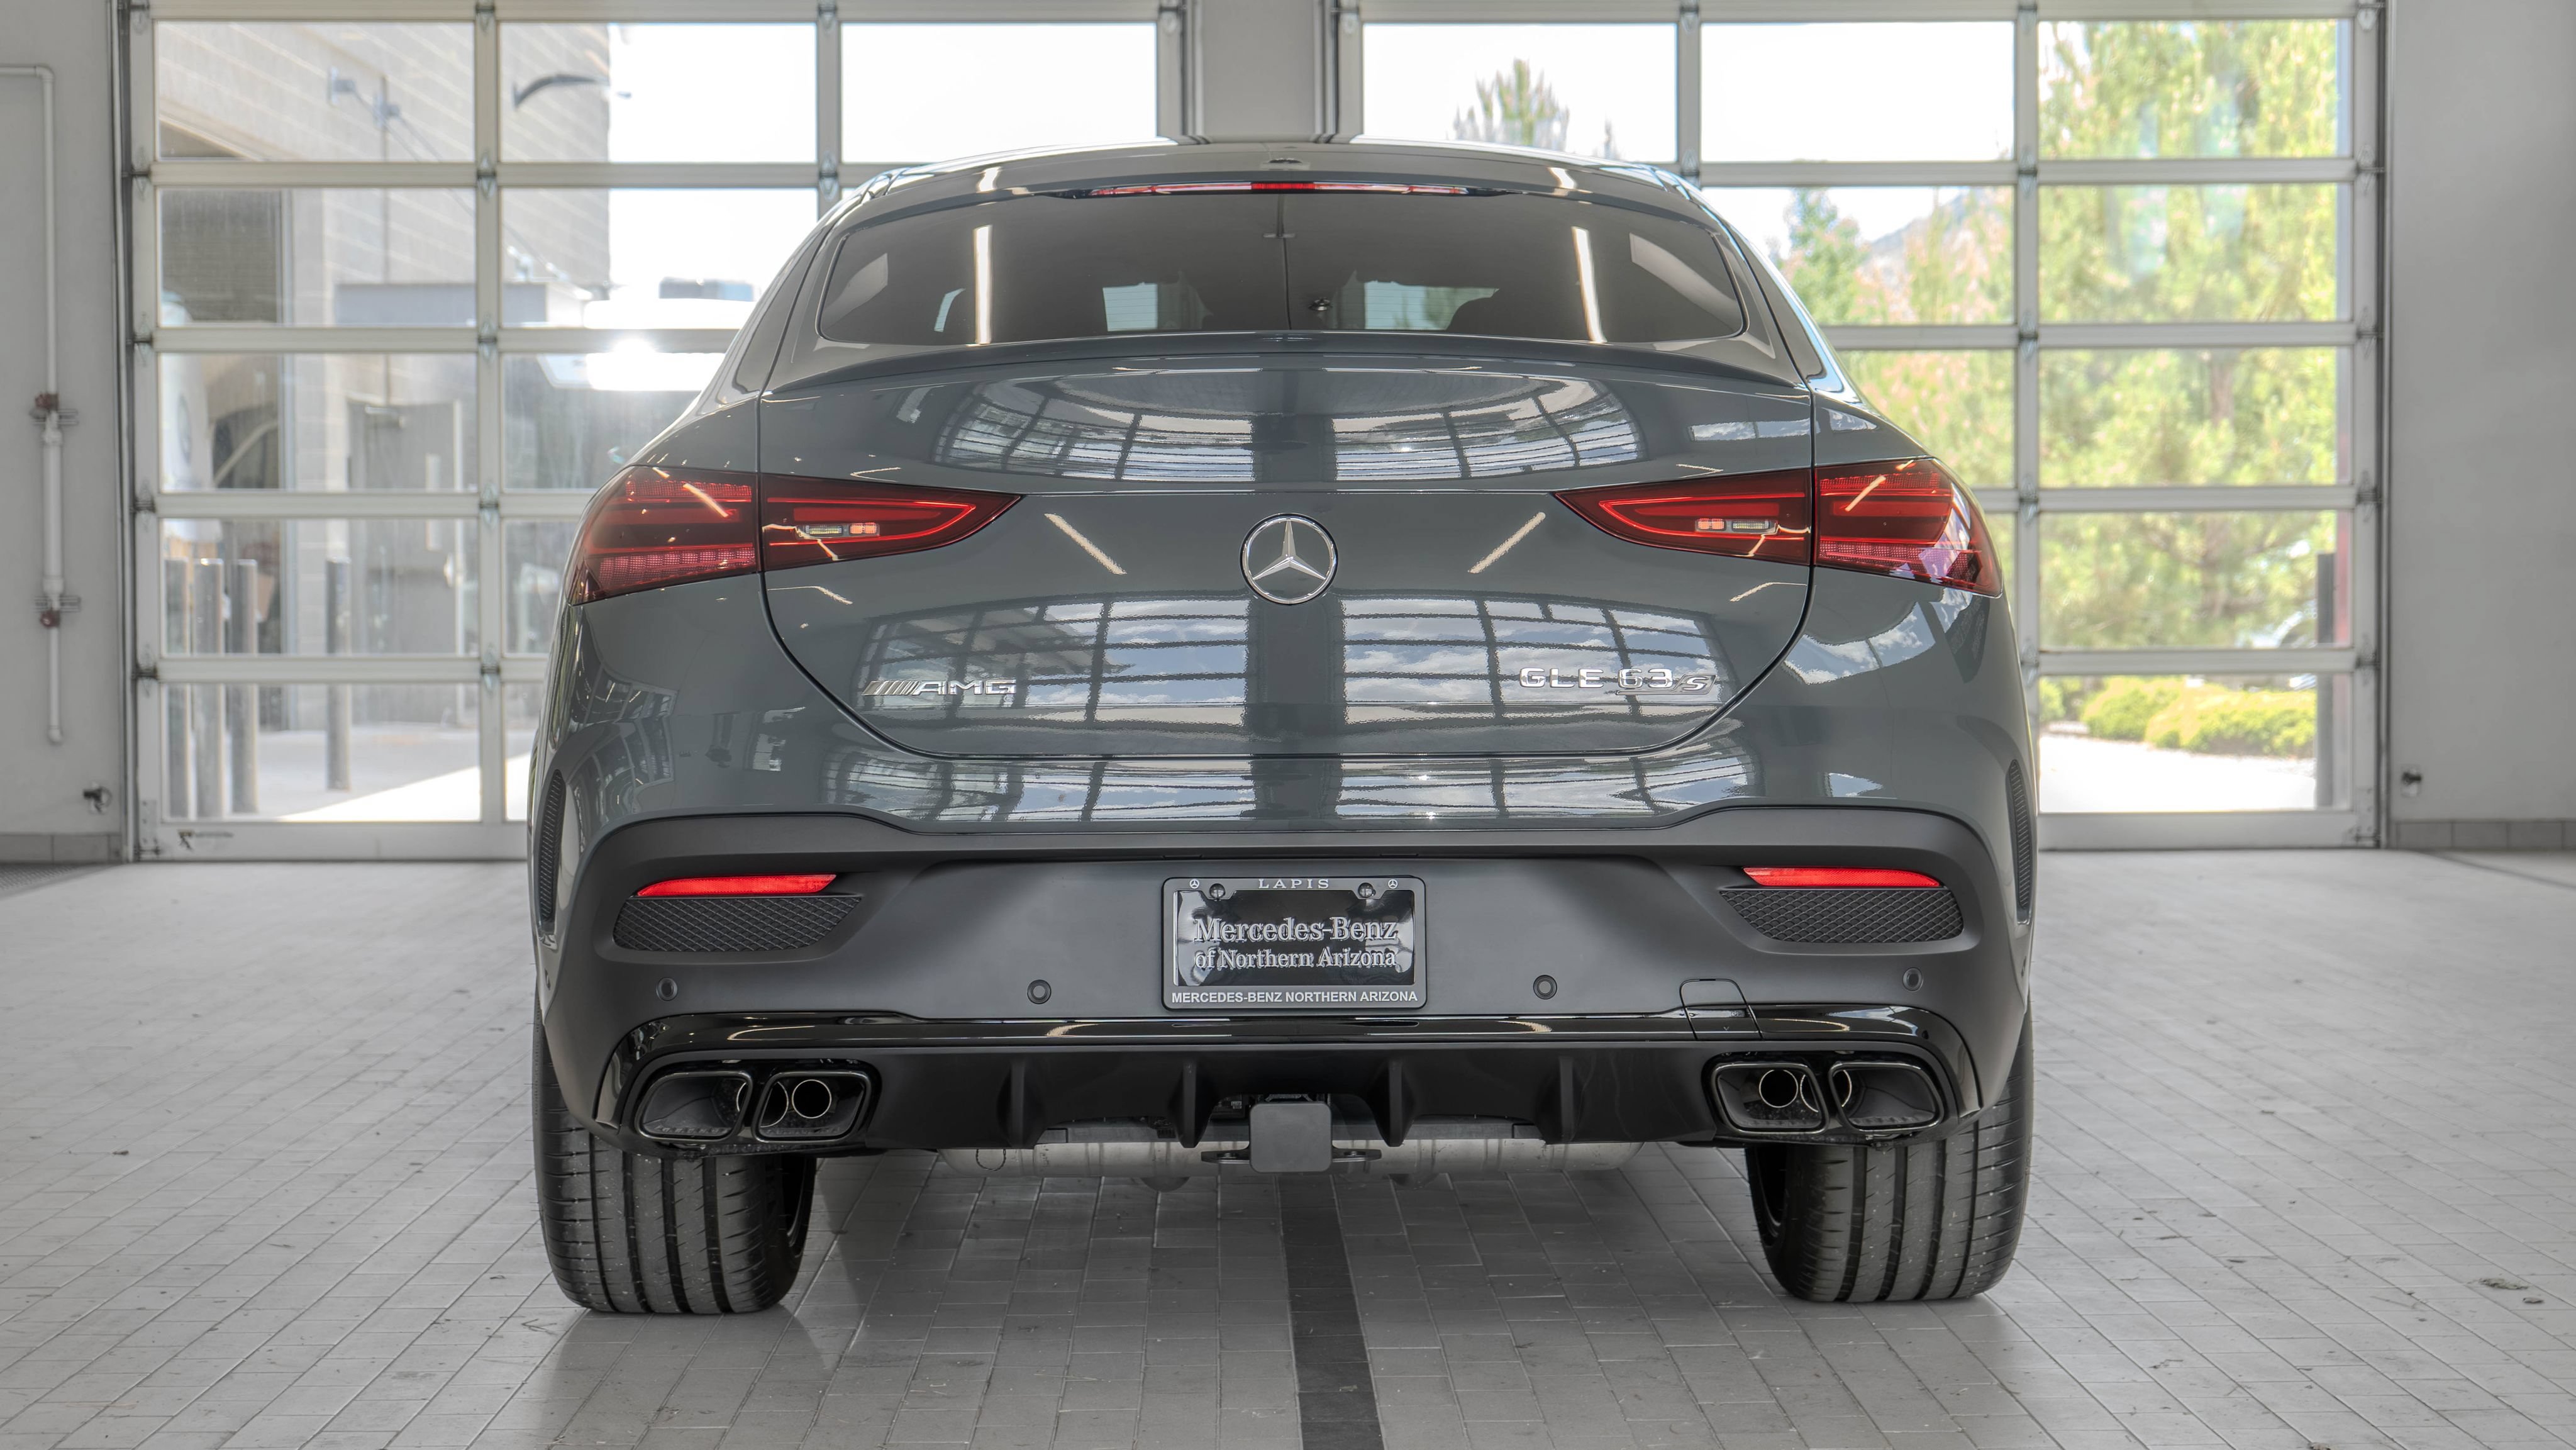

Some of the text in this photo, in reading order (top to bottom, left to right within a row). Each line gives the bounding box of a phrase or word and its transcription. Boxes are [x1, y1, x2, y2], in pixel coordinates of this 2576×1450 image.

[911, 679, 1017, 696] AMG
[1519, 667, 1604, 689] GLE
[1618, 668, 1674, 689] 63
[1258, 878, 1330, 890] LAPIS
[1194, 916, 1398, 942] Mercedes-Benz
[1195, 946, 1397, 969] of Northern Arizona
[1172, 990, 1418, 1003] MERCEDES-BENZ NORTHERN ARIZONA
